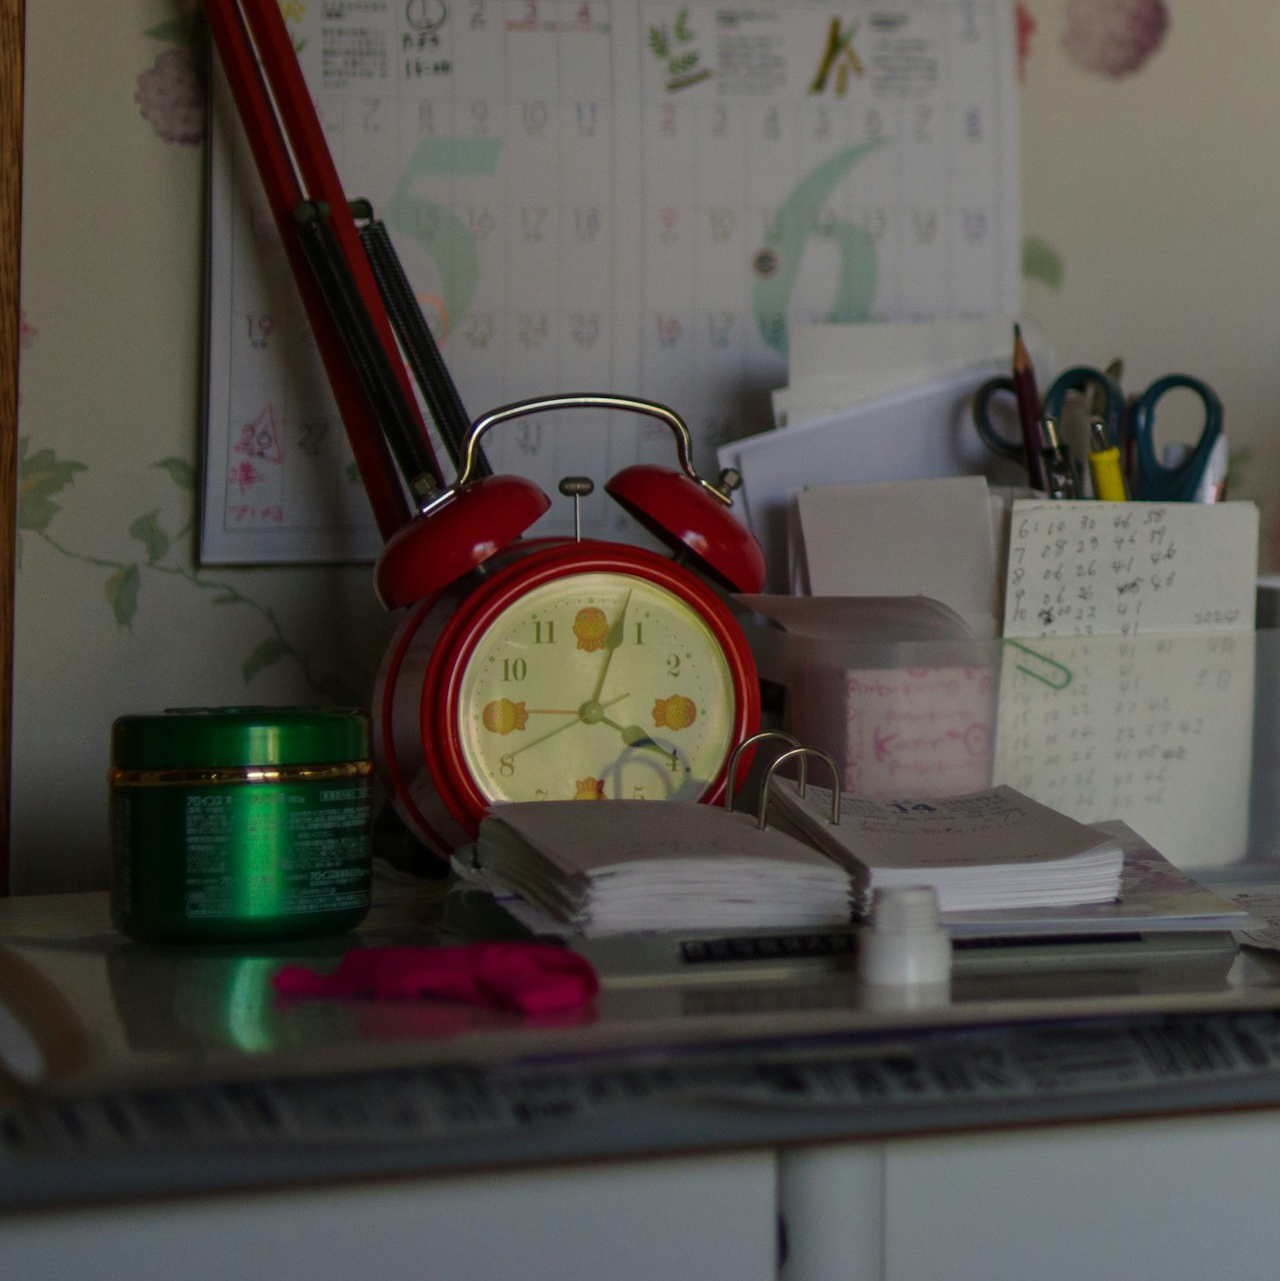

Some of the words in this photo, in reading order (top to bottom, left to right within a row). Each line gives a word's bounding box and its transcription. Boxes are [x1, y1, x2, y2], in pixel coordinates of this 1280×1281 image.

[531, 620, 559, 644] 11
[631, 621, 645, 645] 1
[499, 657, 528, 682] 10
[666, 653, 682, 678] 2
[499, 753, 516, 778] 8
